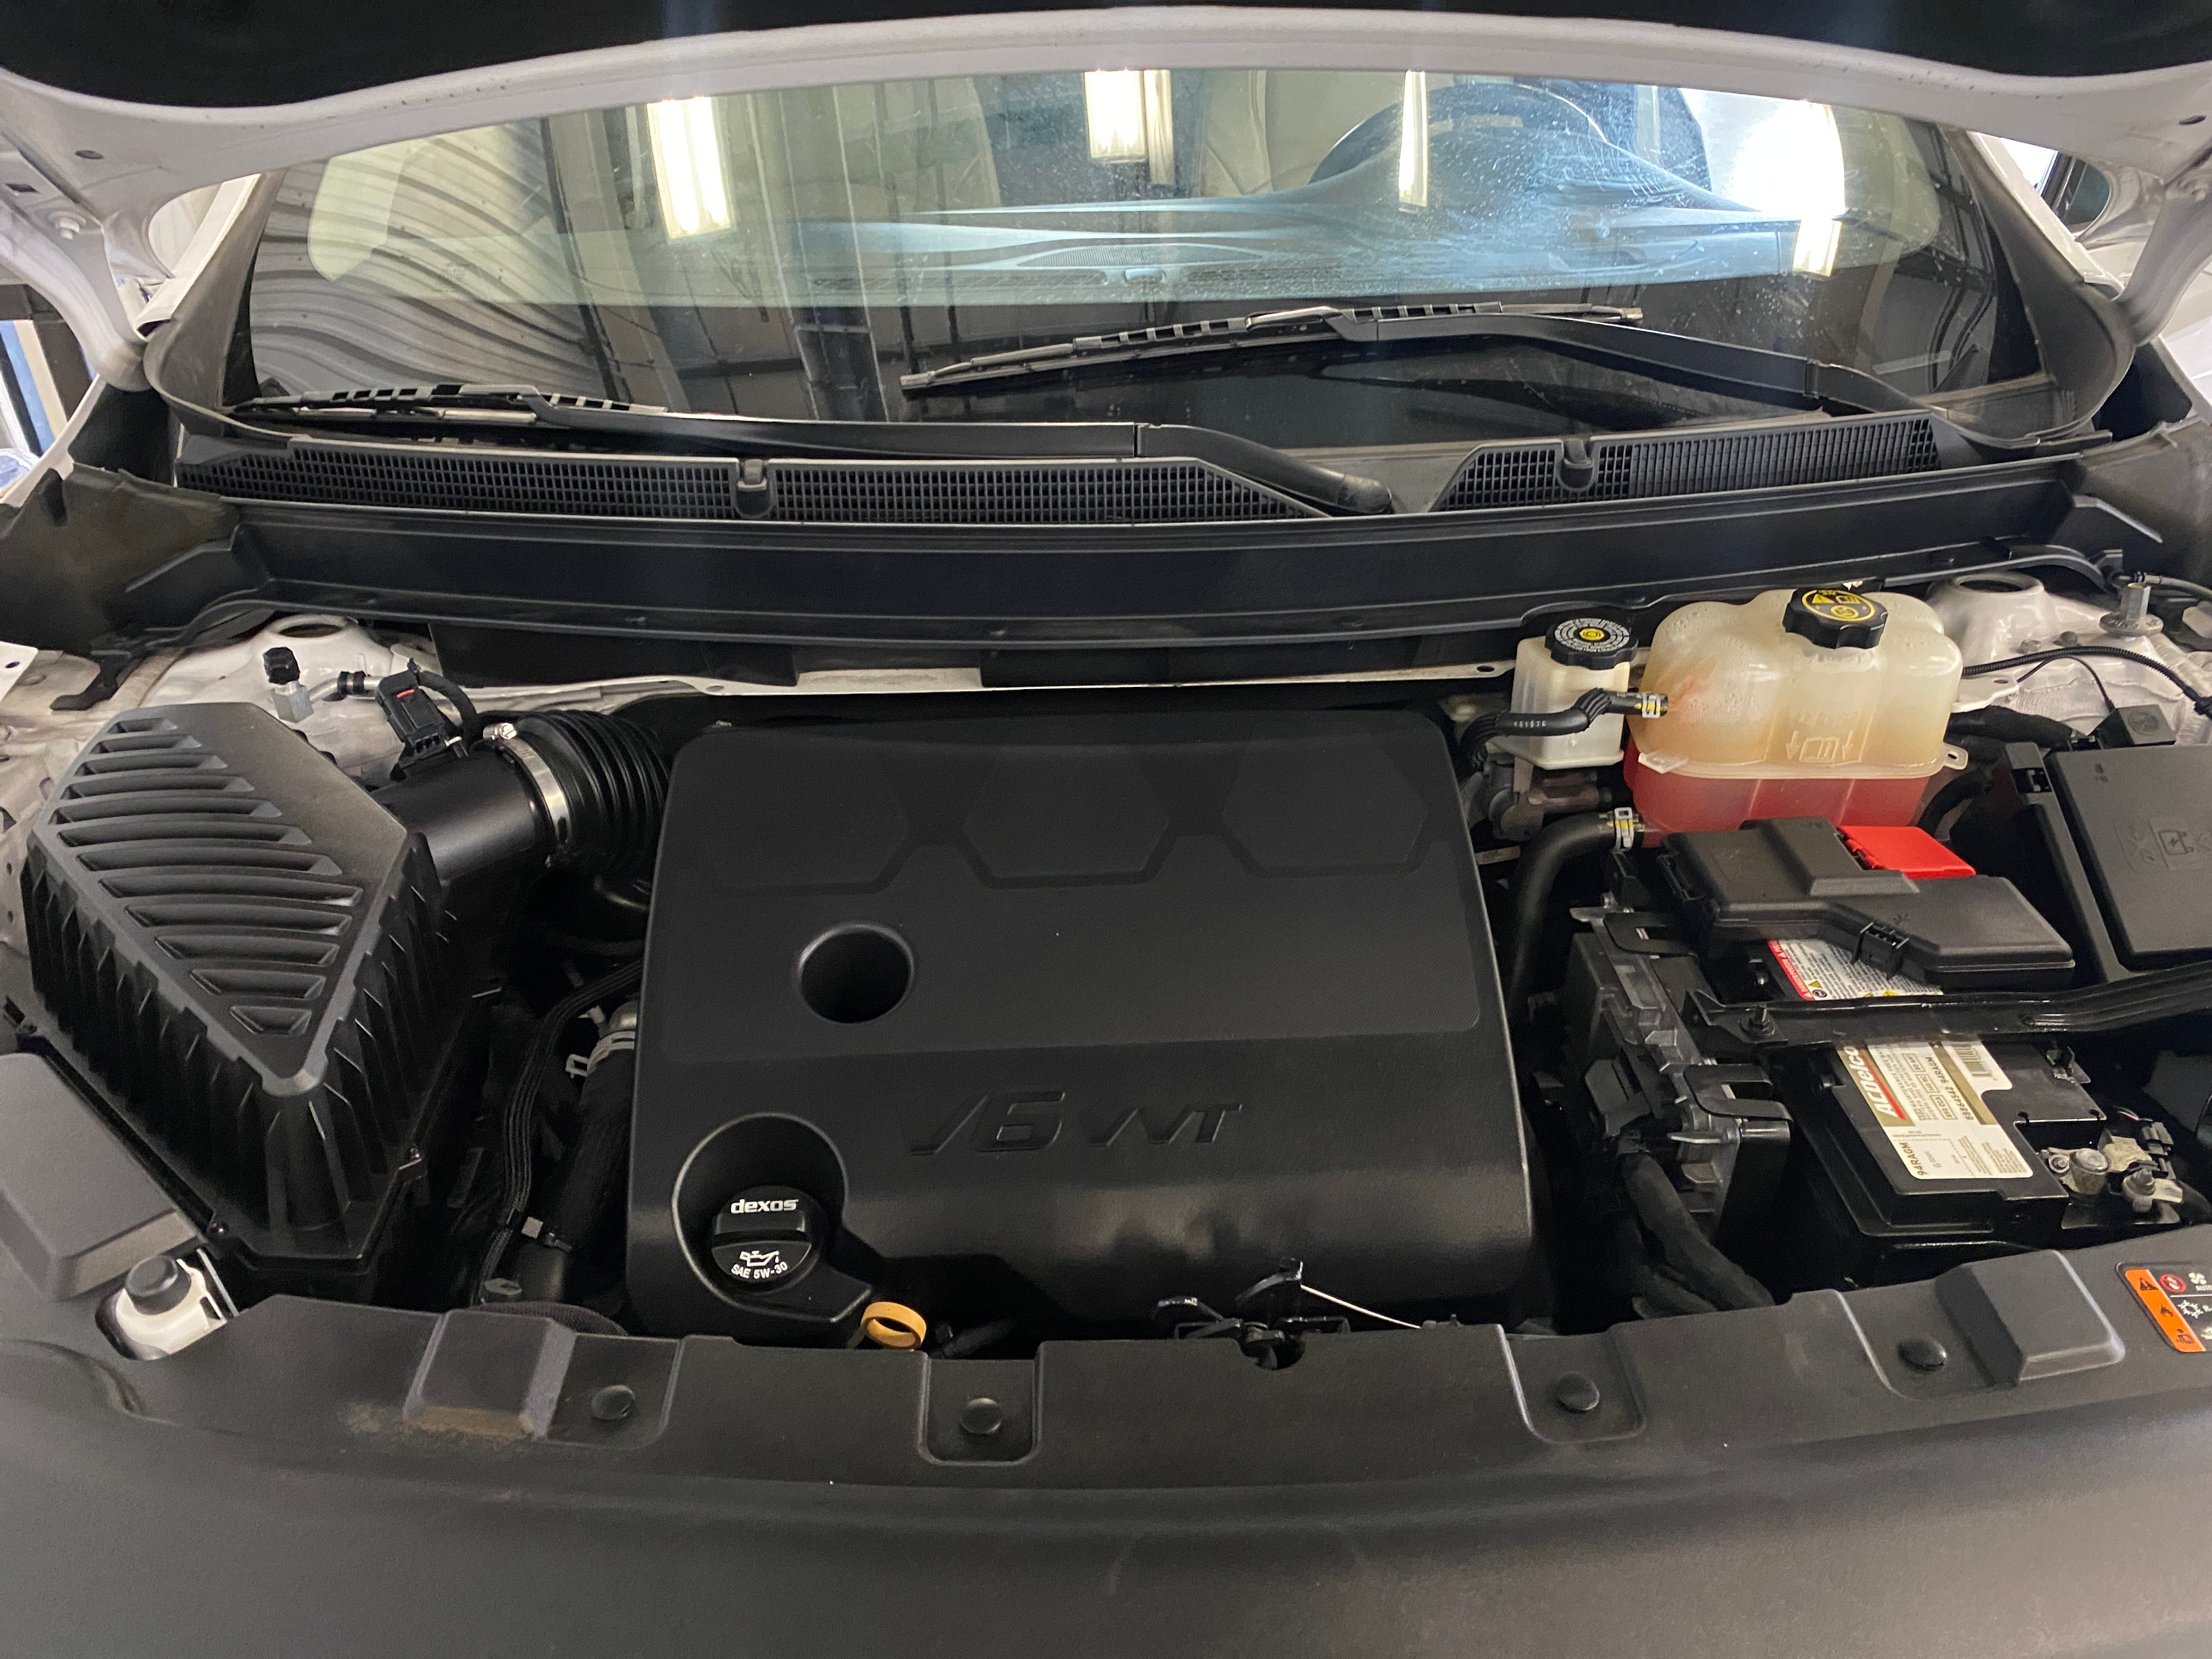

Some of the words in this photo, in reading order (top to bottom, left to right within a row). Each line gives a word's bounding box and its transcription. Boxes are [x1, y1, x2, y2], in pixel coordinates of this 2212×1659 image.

[1843, 1046, 1898, 1117] ACDelco
[1926, 1057, 1949, 1083] 94RAGM
[1899, 1142, 1928, 1176] 94RAGM
[731, 1199, 799, 1214] dexos
[731, 1264, 751, 1278] SAE
[753, 1261, 788, 1279] 5W-30
